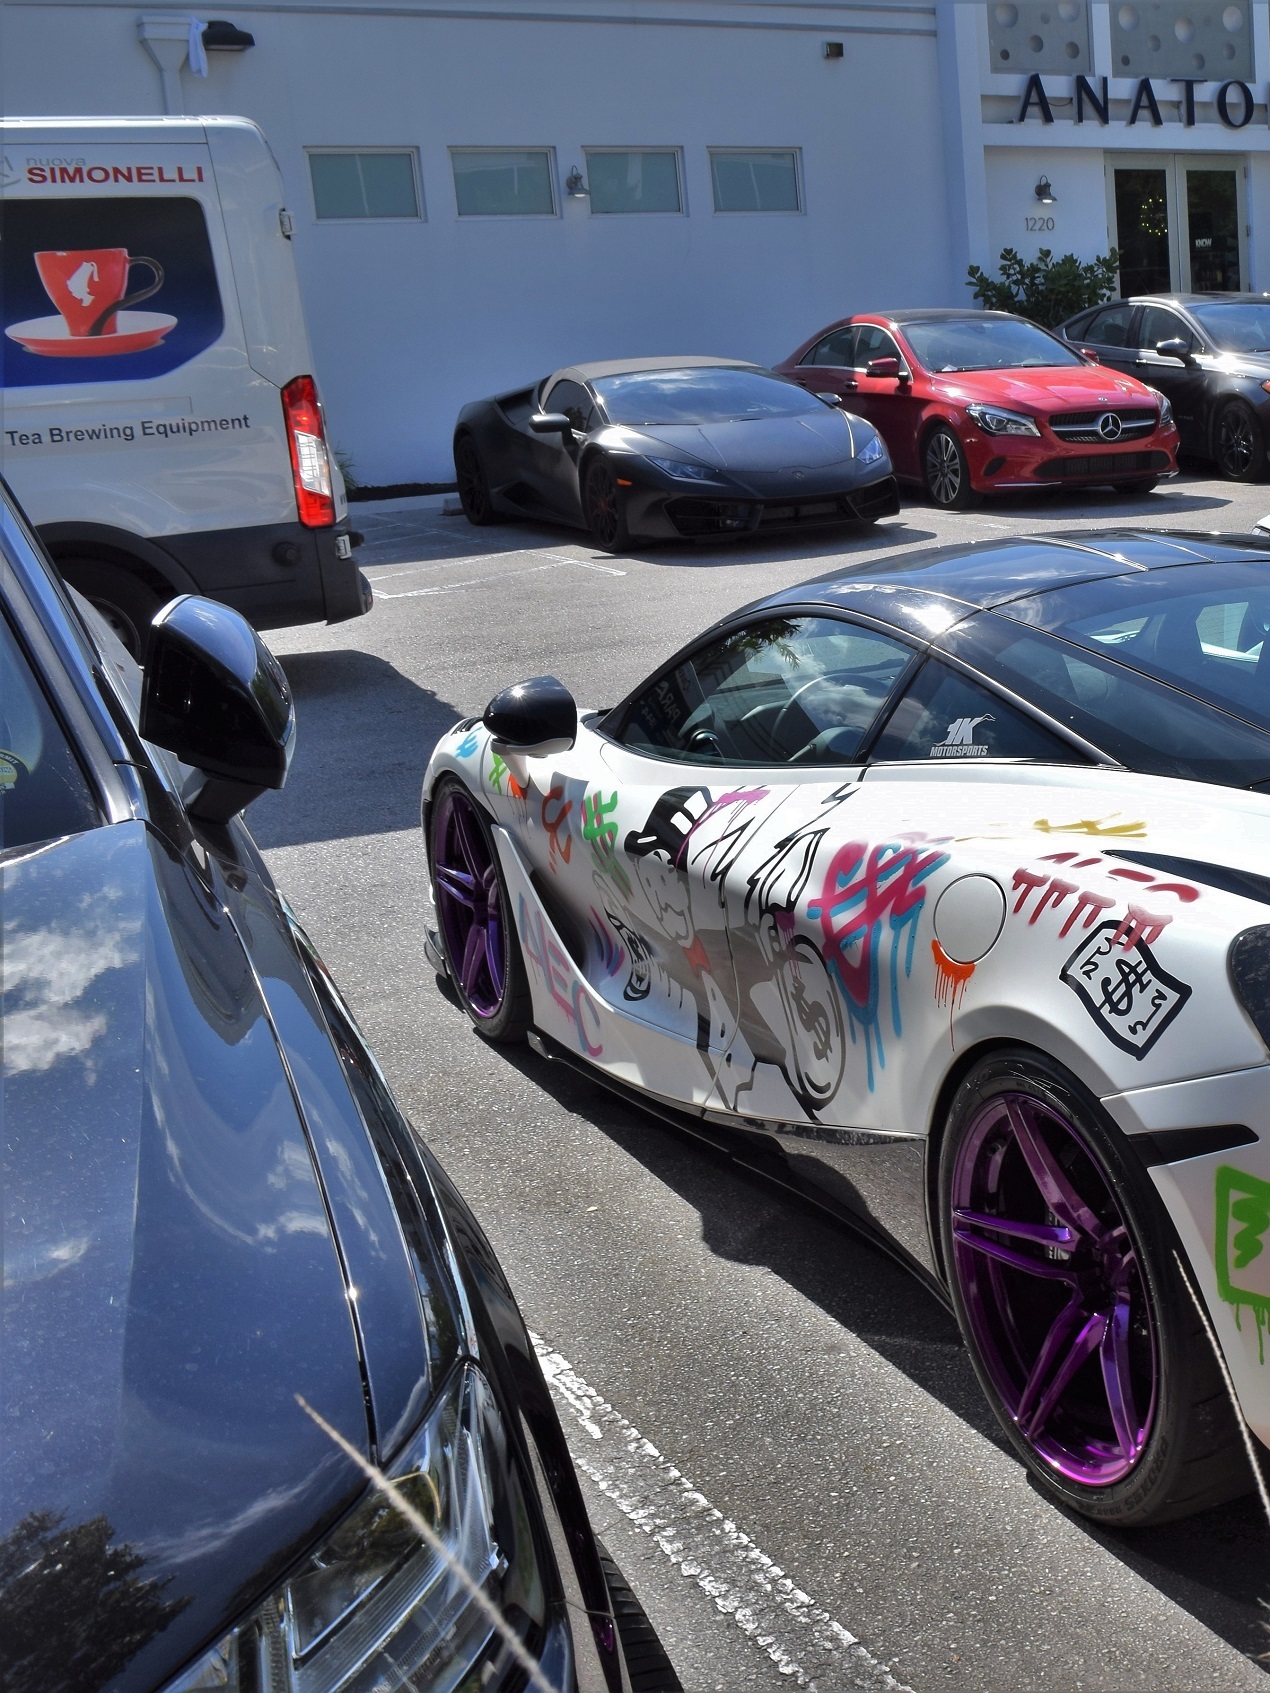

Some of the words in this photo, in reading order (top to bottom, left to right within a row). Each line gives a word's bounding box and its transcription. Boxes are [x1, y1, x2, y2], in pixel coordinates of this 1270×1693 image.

[26, 156, 87, 167] nuova
[27, 166, 204, 184] SIMONELLI
[1025, 216, 1055, 232] 1220
[5, 430, 43, 447] Tea
[49, 424, 135, 442] Brewing
[141, 414, 250, 438] Equipment
[929, 745, 989, 757] MOTORSPORTS
